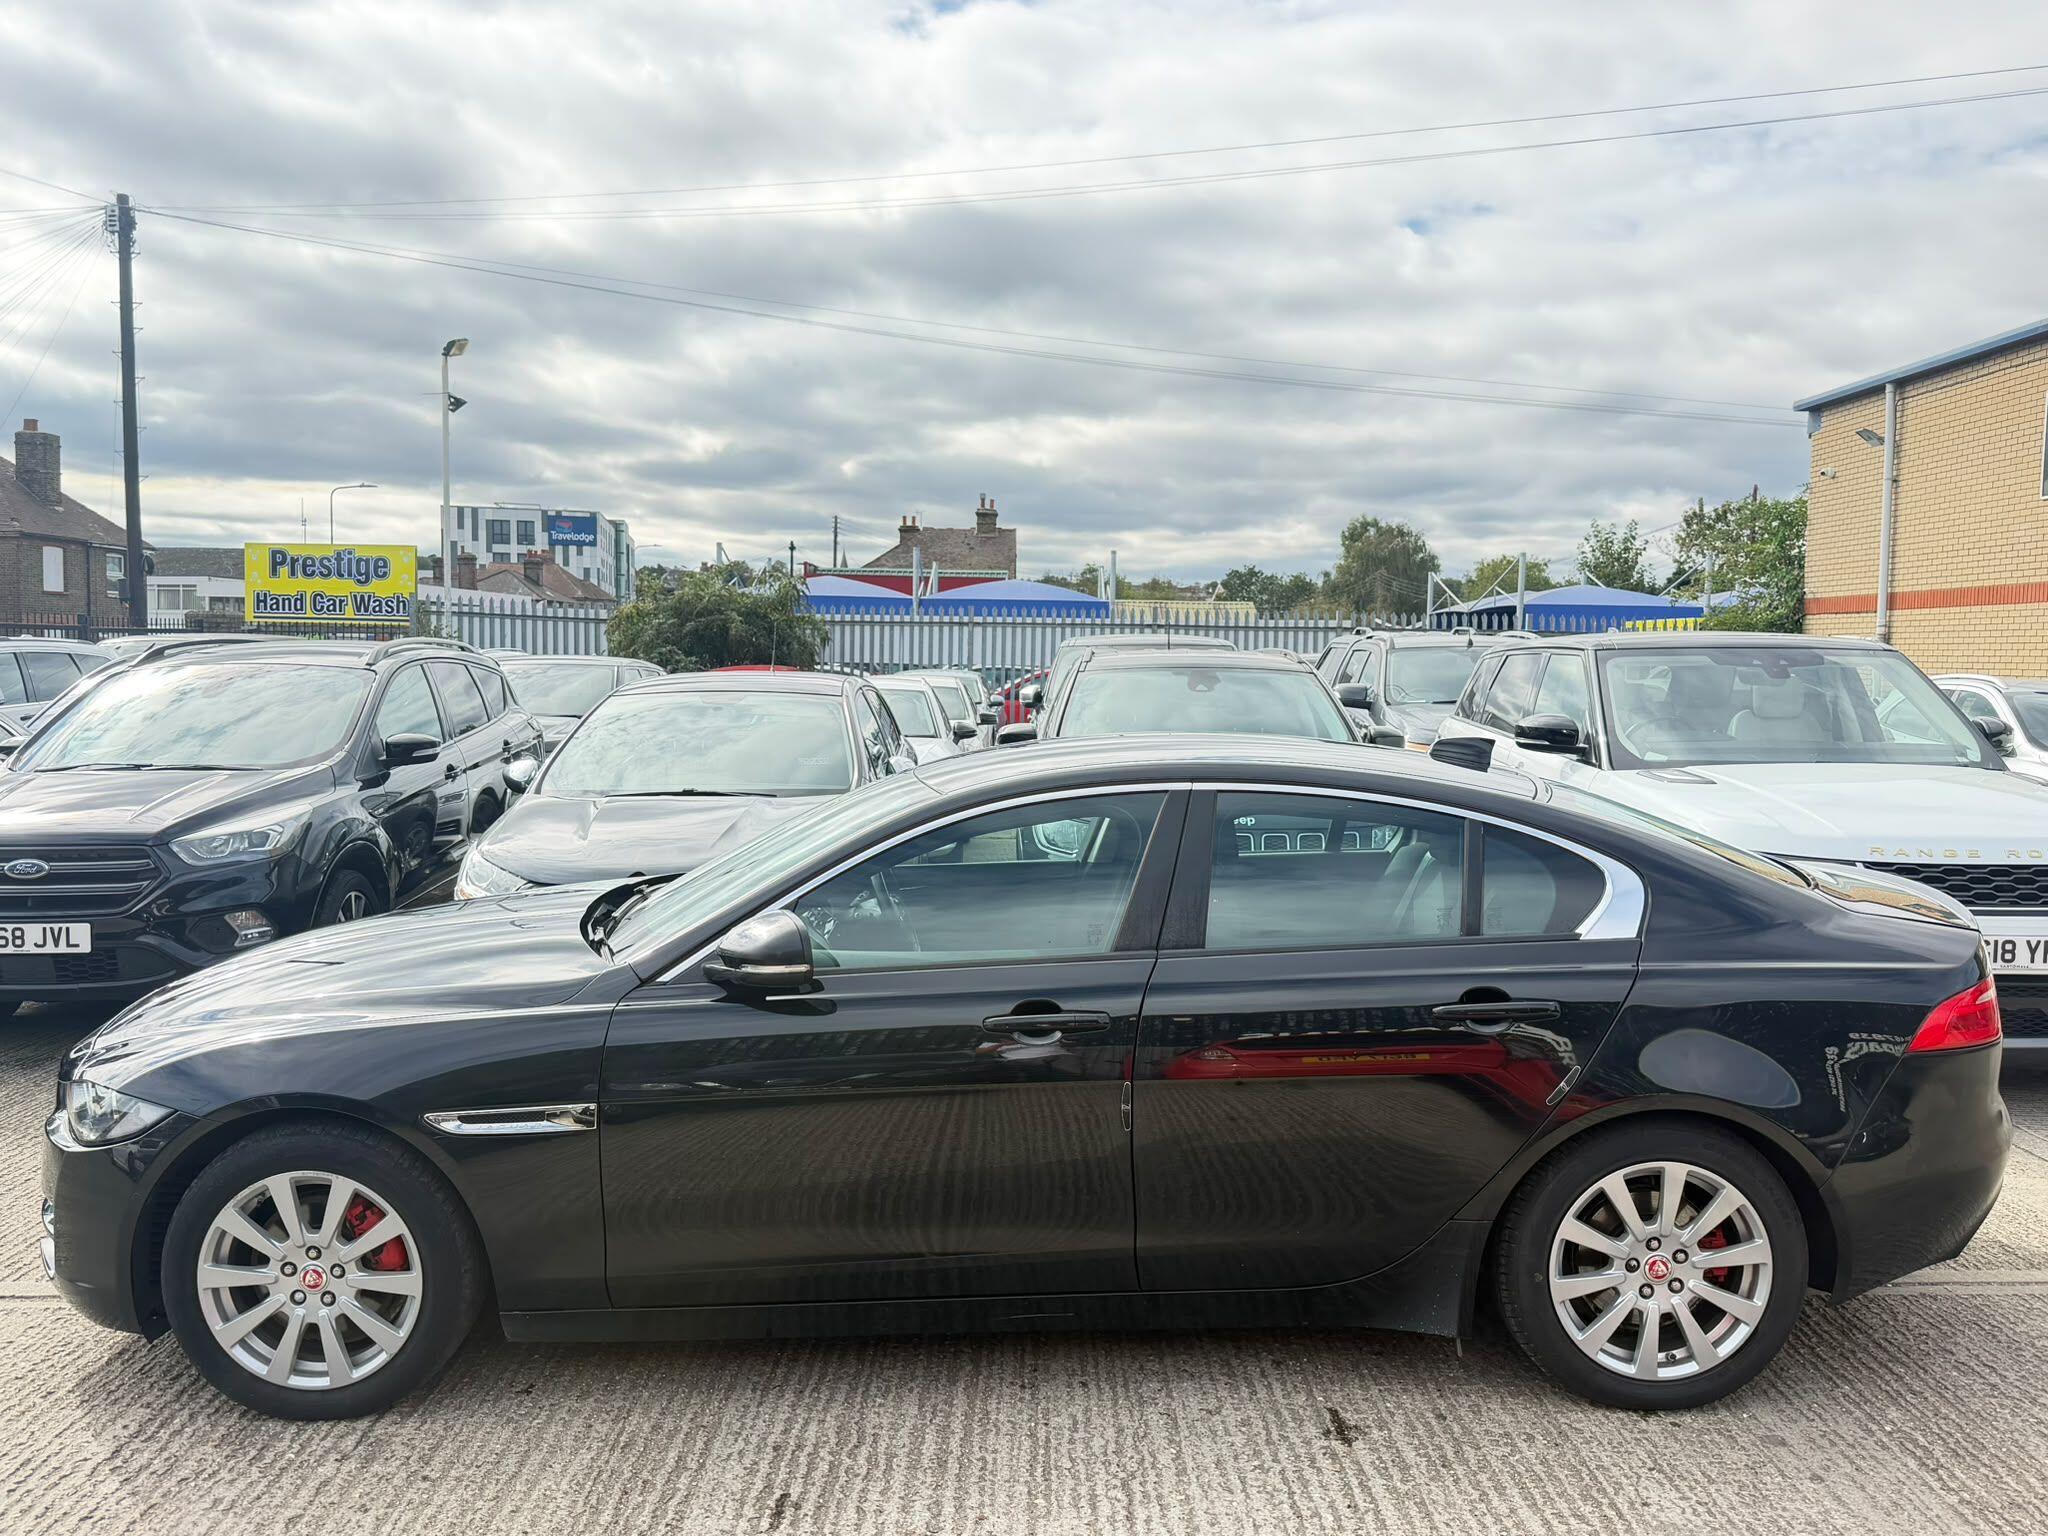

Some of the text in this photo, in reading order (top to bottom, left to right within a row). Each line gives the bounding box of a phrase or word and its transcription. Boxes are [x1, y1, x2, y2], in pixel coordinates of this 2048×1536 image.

[550, 530, 595, 543] Travelodge
[269, 547, 391, 586] Prestige
[253, 590, 410, 617] Hand Car Wash
[1868, 846, 1982, 859] RANGE
[13, 863, 38, 874] Ford
[33, 926, 81, 948] JVL
